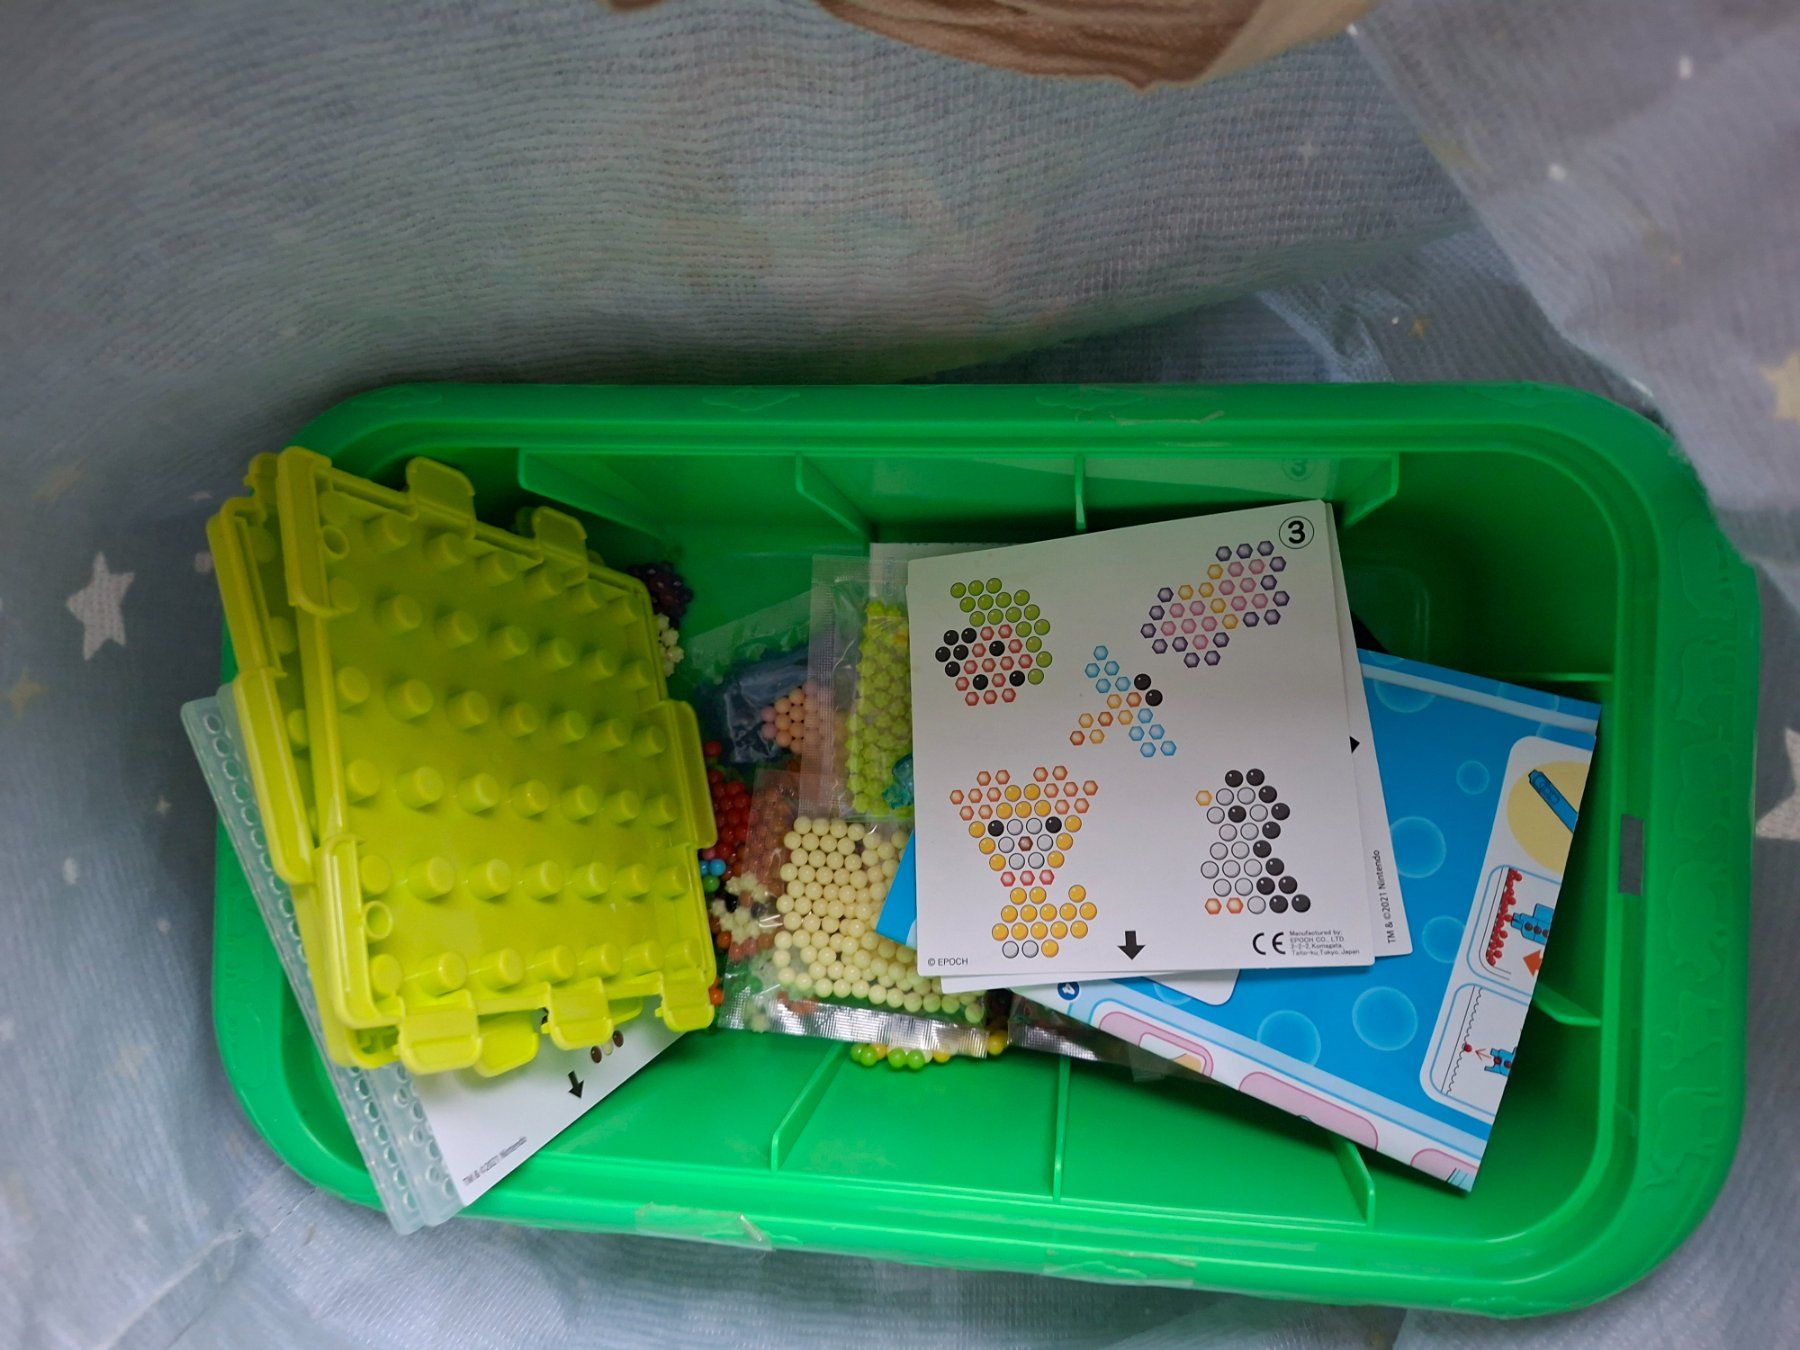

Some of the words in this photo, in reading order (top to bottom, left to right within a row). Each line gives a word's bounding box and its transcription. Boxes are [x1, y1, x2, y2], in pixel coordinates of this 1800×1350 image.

[1287, 519, 1306, 545] 3
[1372, 849, 1386, 890] Nintendo
[1387, 930, 1397, 944] TM
[938, 957, 969, 967] EPOCH
